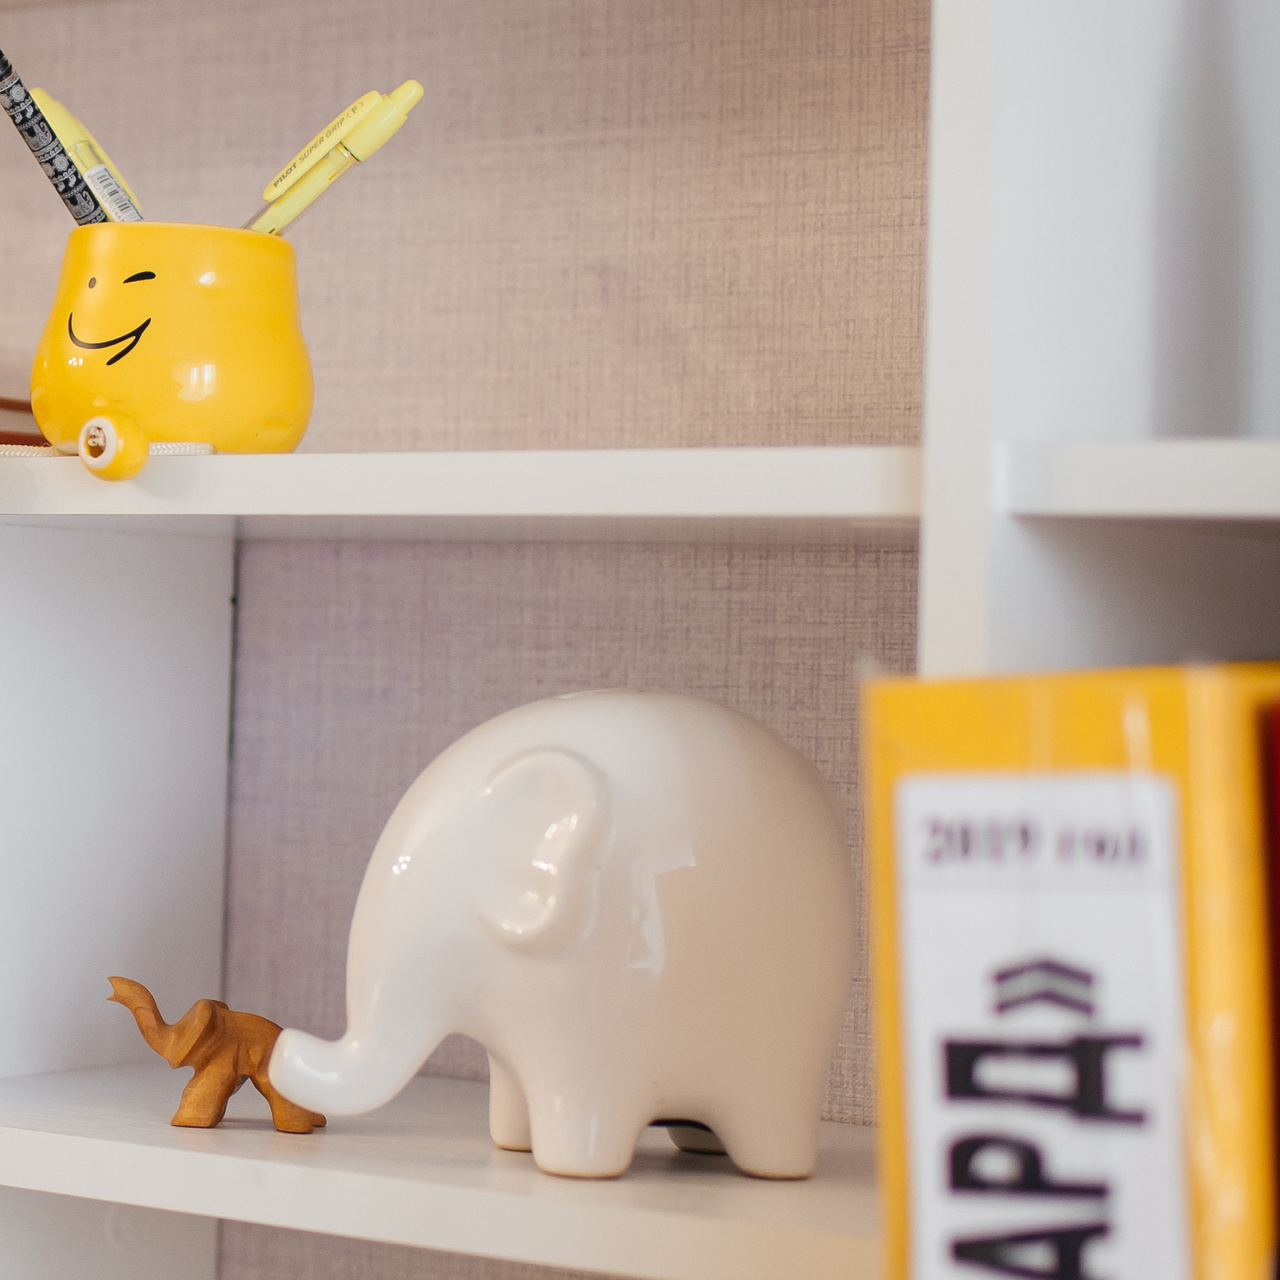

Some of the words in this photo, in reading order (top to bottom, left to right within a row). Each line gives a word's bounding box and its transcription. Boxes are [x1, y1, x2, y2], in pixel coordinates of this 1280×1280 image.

[273, 161, 298, 188] PILOT
[298, 136, 325, 164] SUPER
[325, 117, 346, 138] GRIP
